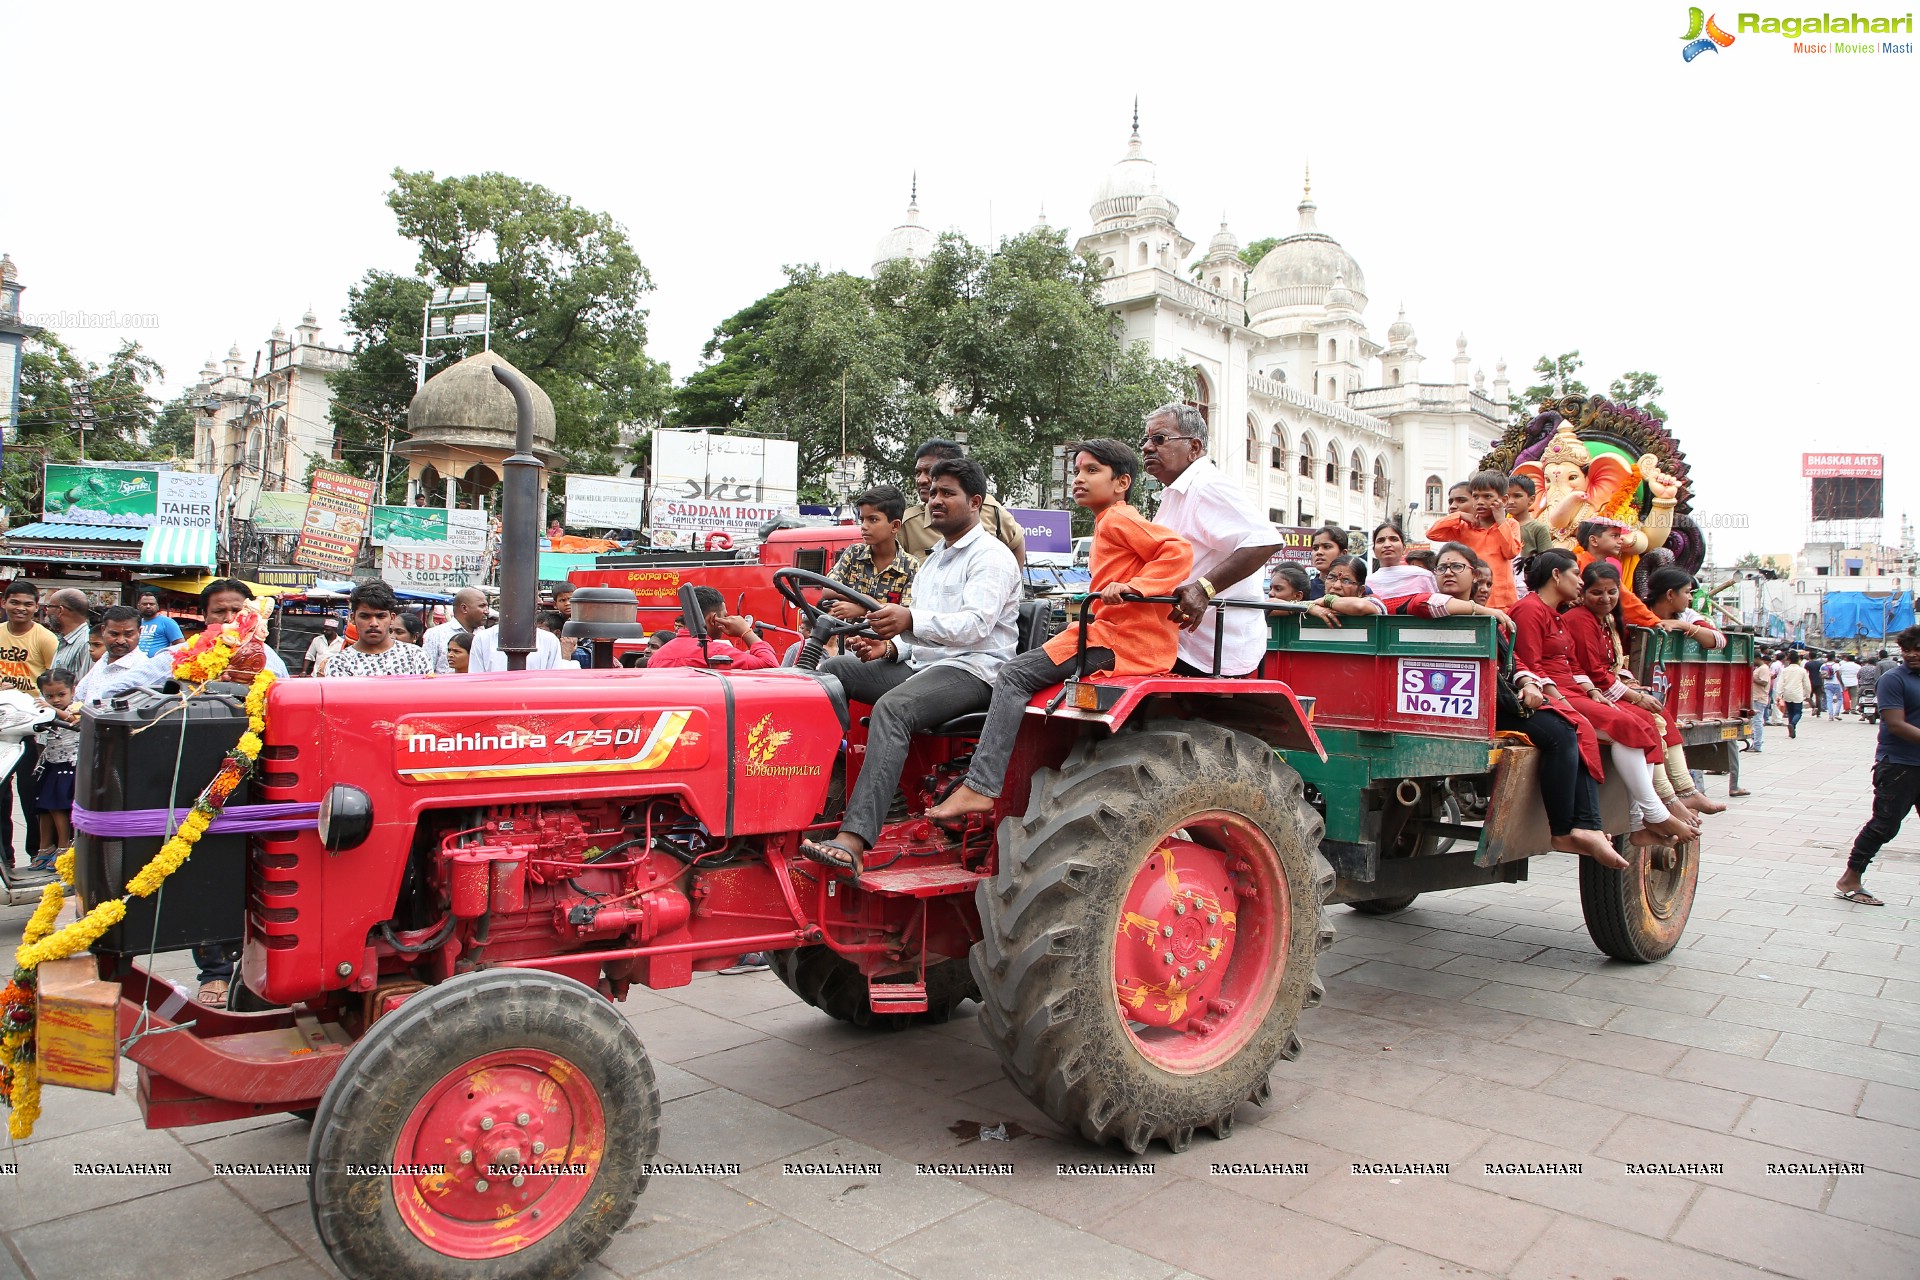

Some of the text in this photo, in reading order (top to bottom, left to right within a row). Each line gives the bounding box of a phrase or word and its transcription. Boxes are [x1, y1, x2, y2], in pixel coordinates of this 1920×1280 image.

[1808, 456, 1878, 466] BHASKAR ARTS
[121, 481, 150, 494] Sprite
[317, 471, 372, 489] MUQADDAR HOTEL
[162, 502, 210, 516] TAHER
[668, 503, 730, 519] SADDAM
[160, 516, 211, 528] PAN SHOP
[672, 516, 696, 525] FAMILY
[698, 516, 728, 526] SECTION
[727, 519, 744, 527] ALSO
[388, 552, 452, 571] NEEDS
[258, 572, 317, 585] MUQADDAR HOTE
[407, 572, 468, 583] & COOL POINT
[1404, 670, 1472, 696] S Z
[1406, 694, 1472, 715] No. 712
[408, 732, 546, 752] Mahindra
[745, 764, 820, 780] Bhoomiputra
